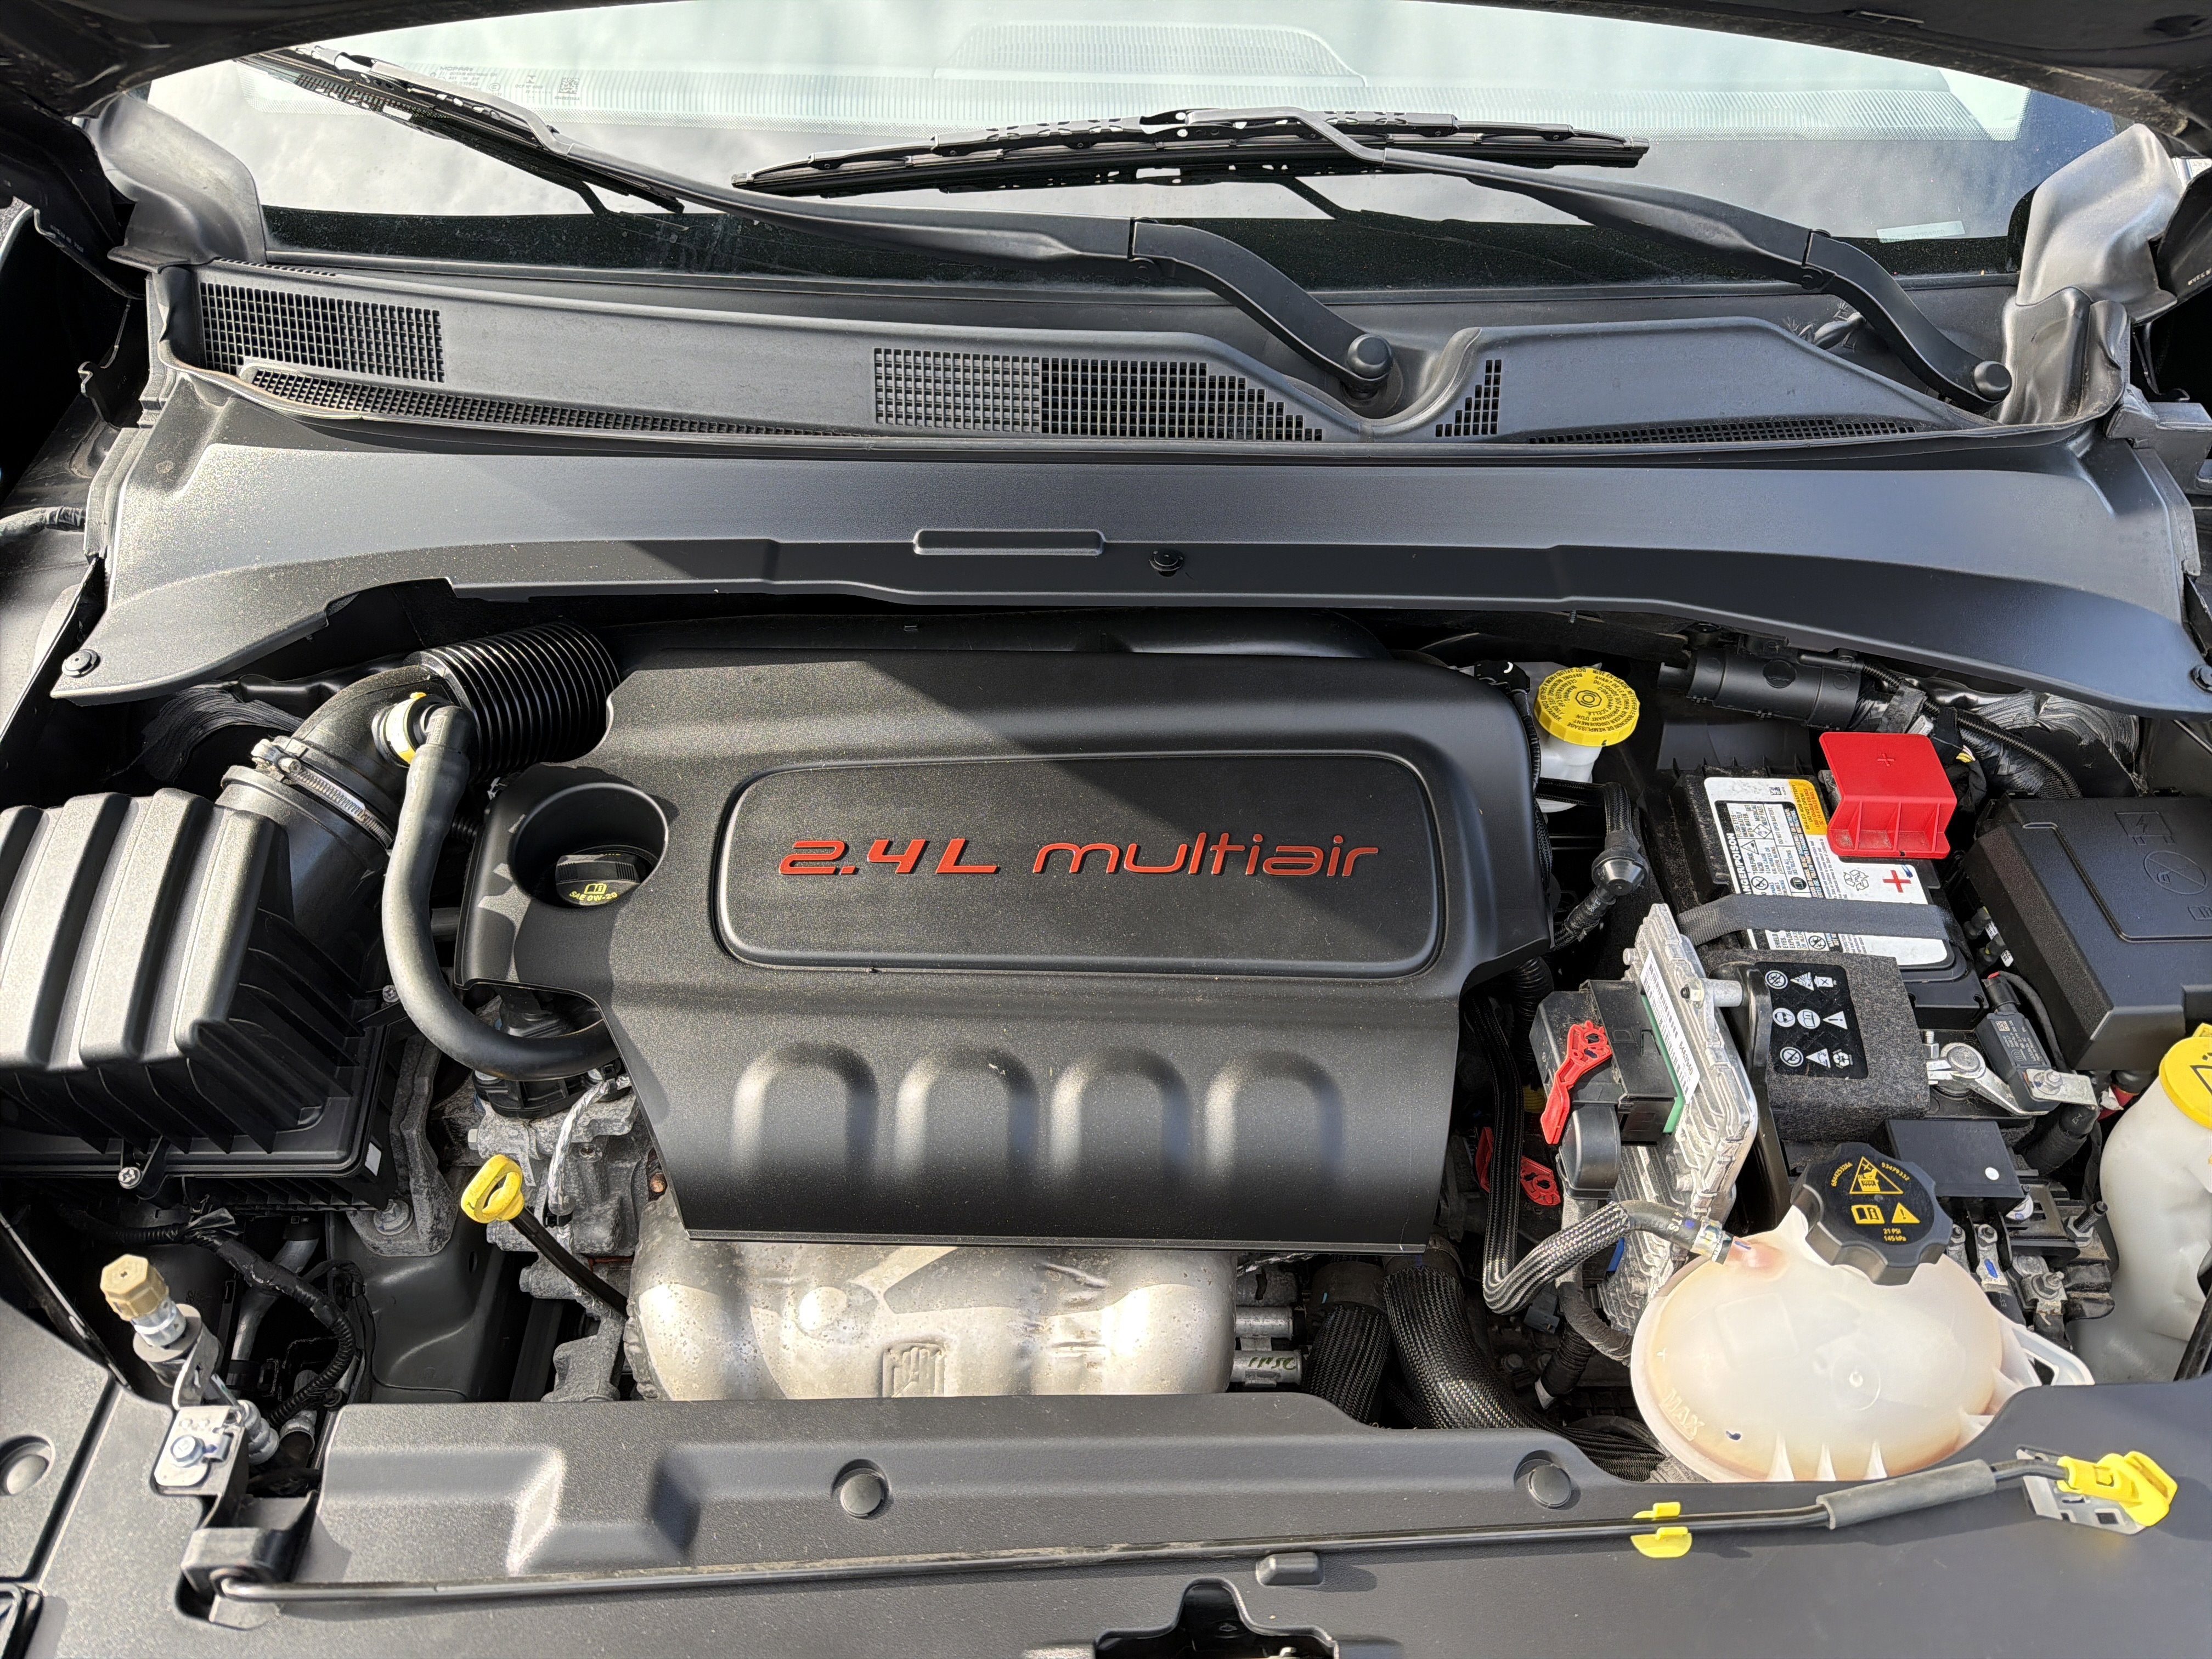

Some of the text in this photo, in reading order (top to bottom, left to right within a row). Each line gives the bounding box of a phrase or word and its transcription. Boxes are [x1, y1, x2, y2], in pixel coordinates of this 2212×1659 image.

[1595, 675, 1612, 684] AVANT
[1552, 706, 1564, 715] ONLY
[1566, 722, 1606, 732] REMPLISSAGE
[1791, 784, 1801, 802] BATTERY
[1751, 805, 1760, 821] MEDICAL
[1759, 816, 1768, 825] HELP
[1736, 811, 1748, 837] IMMEDIATELY
[1801, 814, 1810, 829] SEALED
[1032, 832, 1380, 877] multiair
[1747, 853, 1758, 871] SULFURIC
[569, 891, 618, 901] SAE 0W-20
[1772, 933, 1781, 948] SHIELD
[1662, 1388, 1705, 1436] MAX
